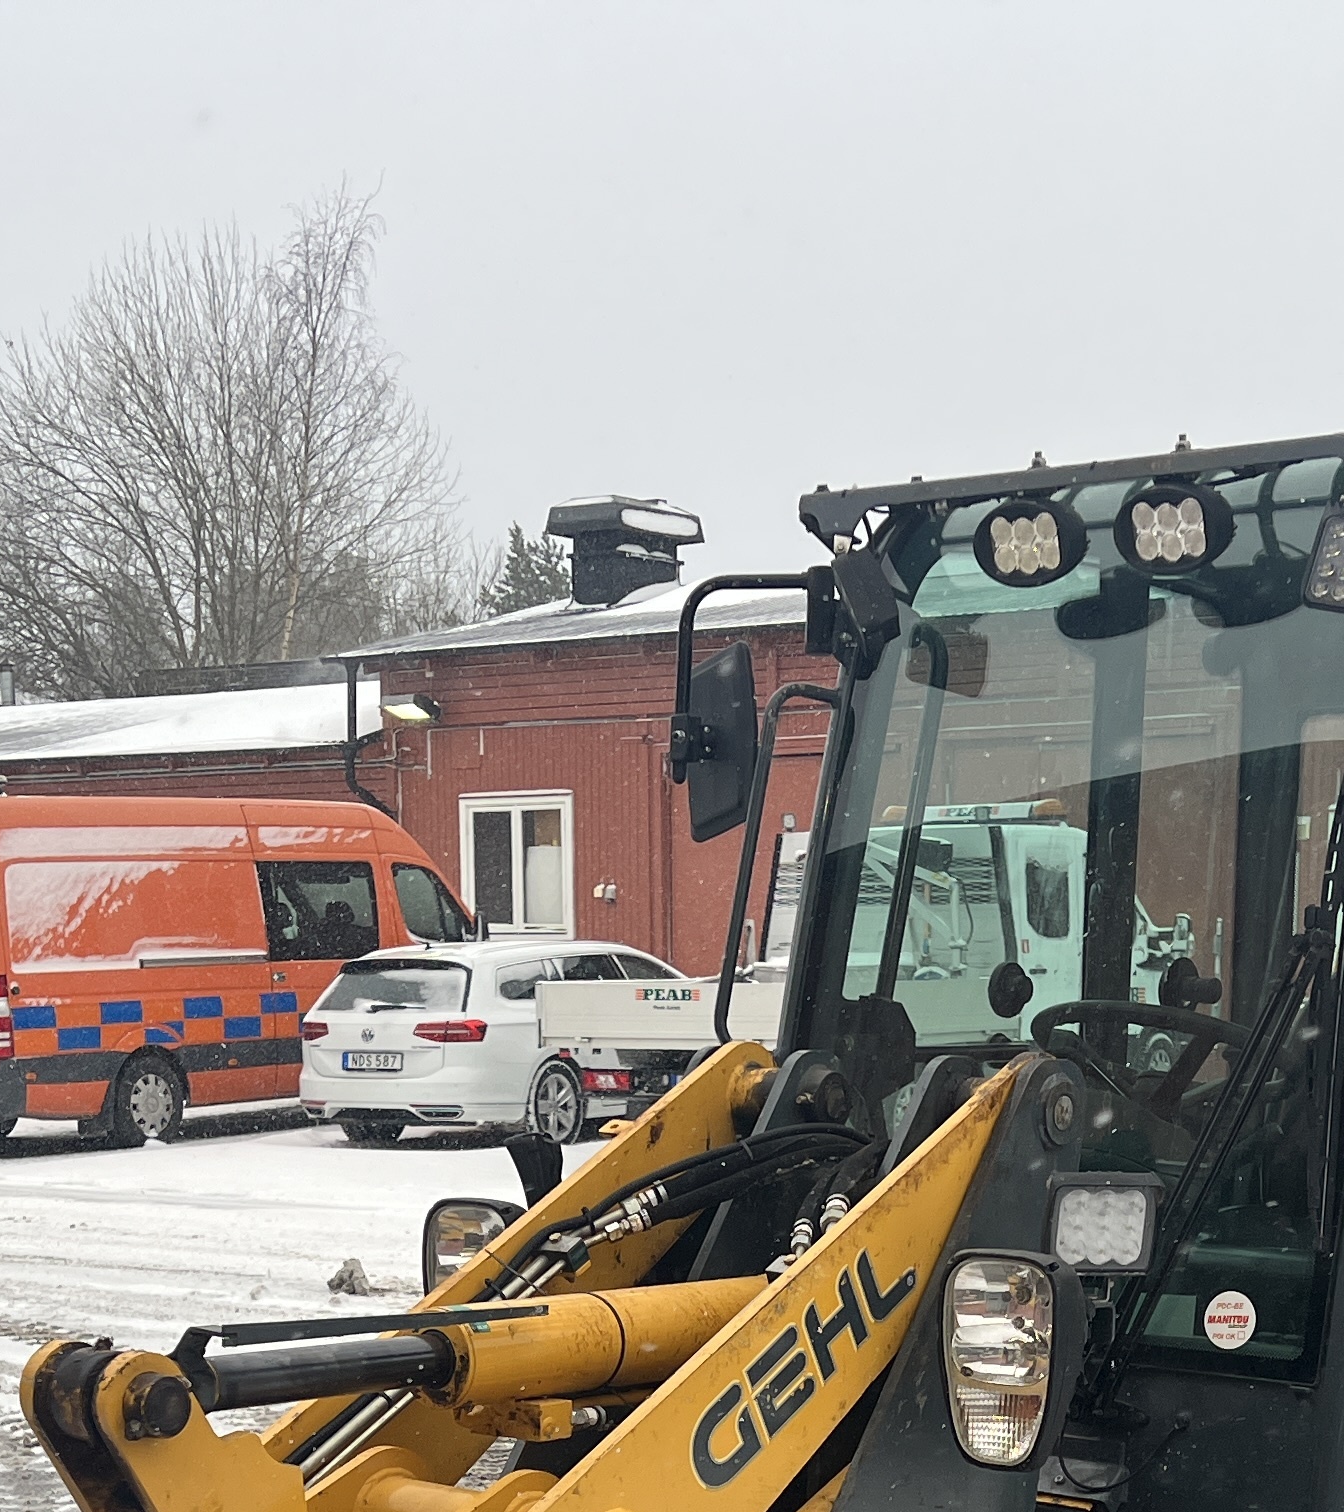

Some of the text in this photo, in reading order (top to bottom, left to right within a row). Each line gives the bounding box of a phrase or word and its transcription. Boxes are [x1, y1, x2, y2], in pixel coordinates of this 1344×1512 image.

[642, 989, 692, 1001] PEAB
[351, 1054, 397, 1067] NDS 587
[1207, 1315, 1249, 1324] MANITOU
[690, 1246, 917, 1490] GEHL
